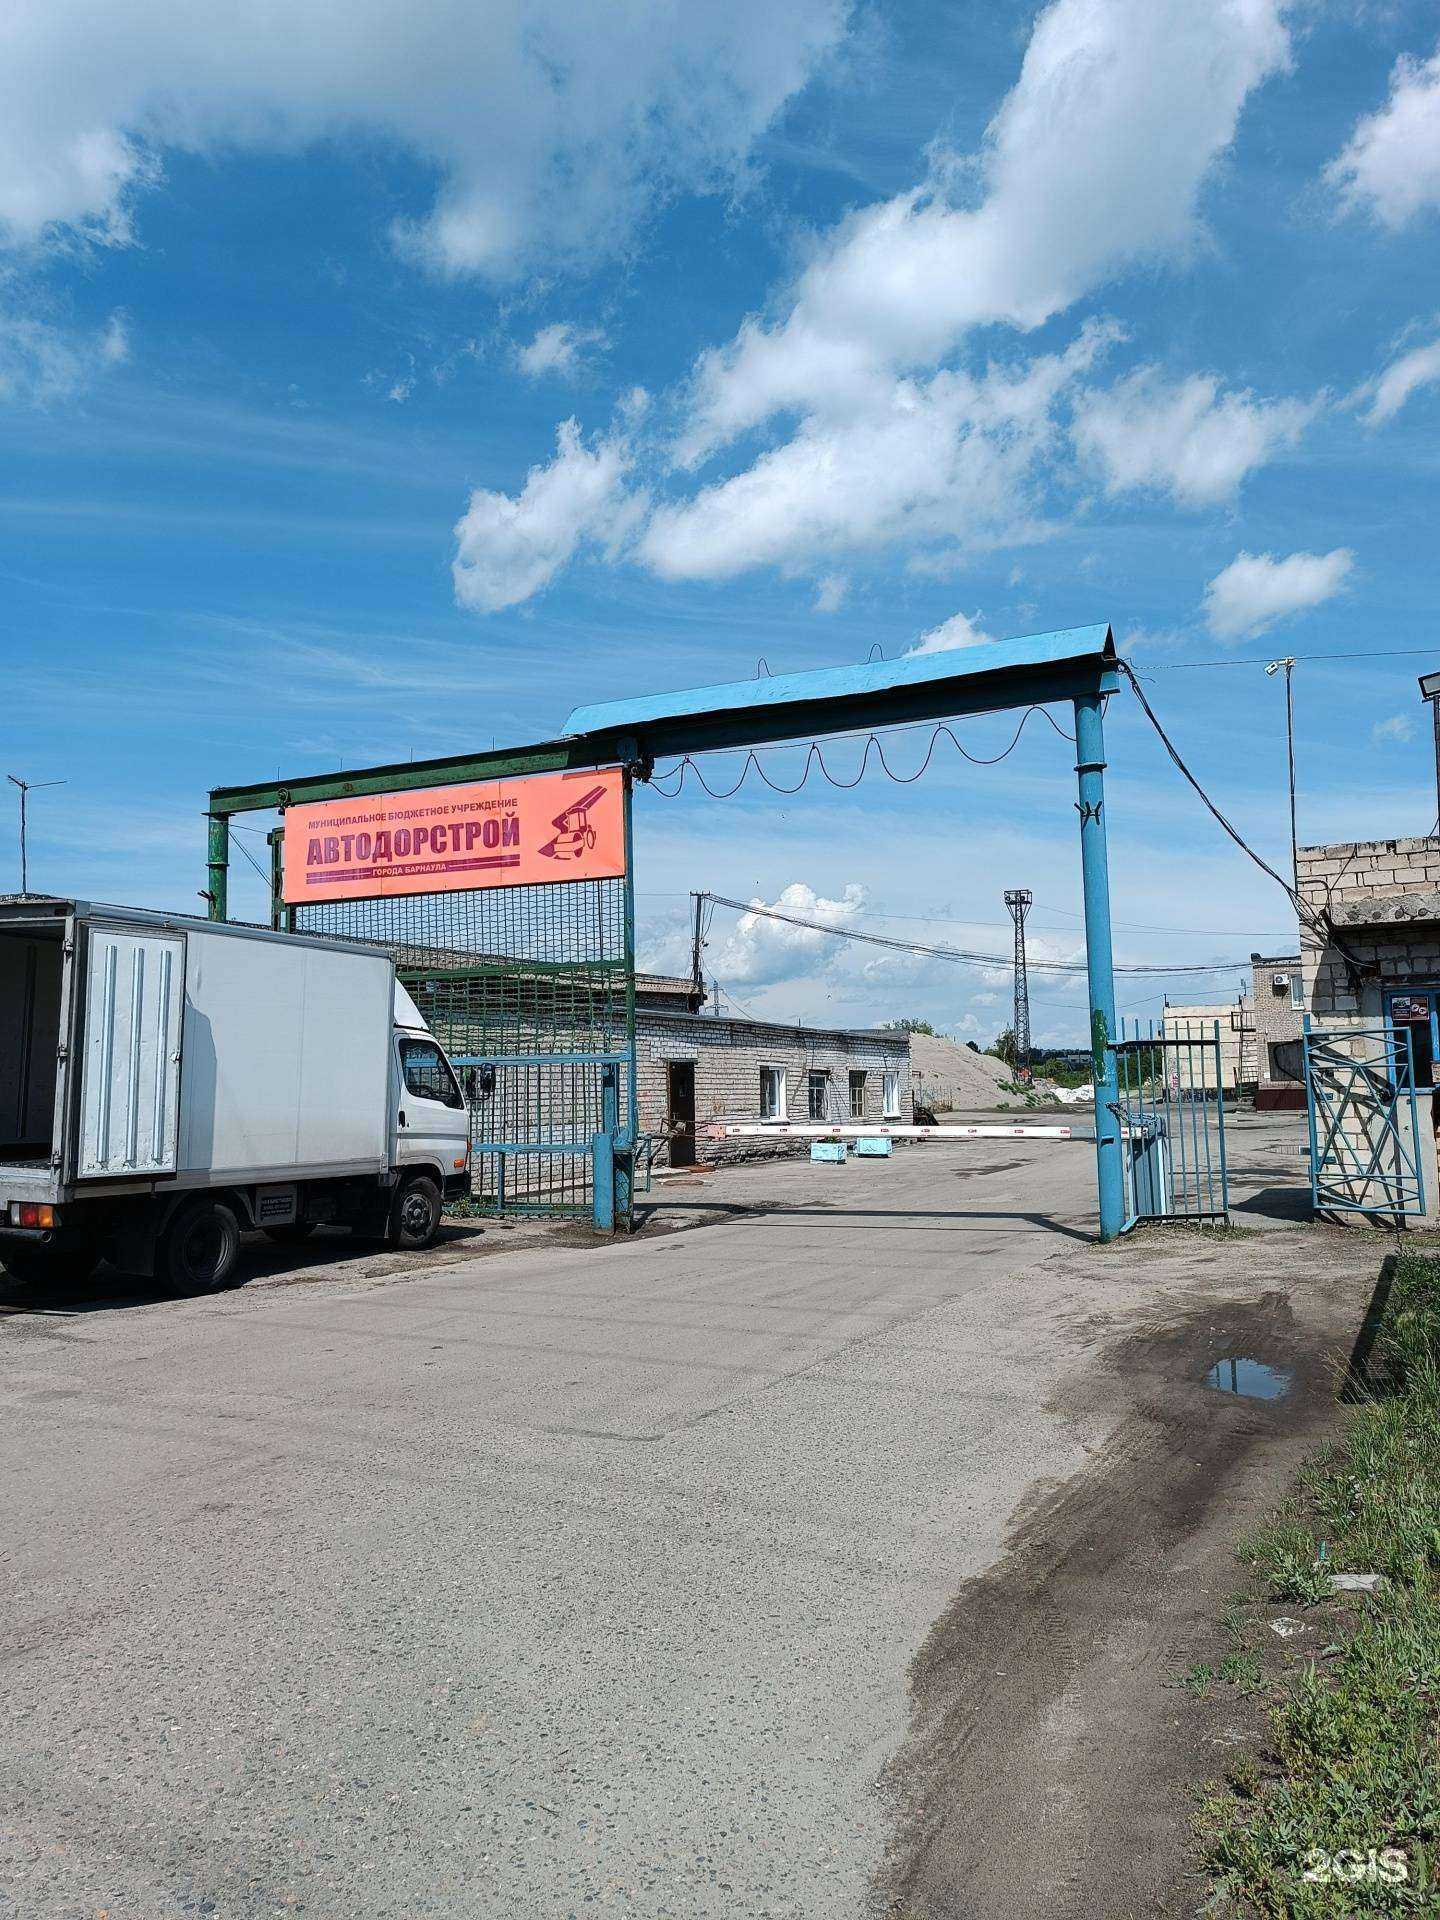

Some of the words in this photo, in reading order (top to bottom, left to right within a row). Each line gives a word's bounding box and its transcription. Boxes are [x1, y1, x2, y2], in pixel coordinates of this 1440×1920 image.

[308, 812, 387, 829] МУНИЦИПАЛЬНОЕ
[388, 806, 450, 821] БЮДЖЕТНОЕ
[451, 798, 518, 813] УЧРЕЖДЕНИЕ
[306, 812, 520, 865] АВТОДОРСТРОЙ
[372, 866, 404, 877] ГОРОДА
[405, 863, 447, 875] БАРНАУЛА
